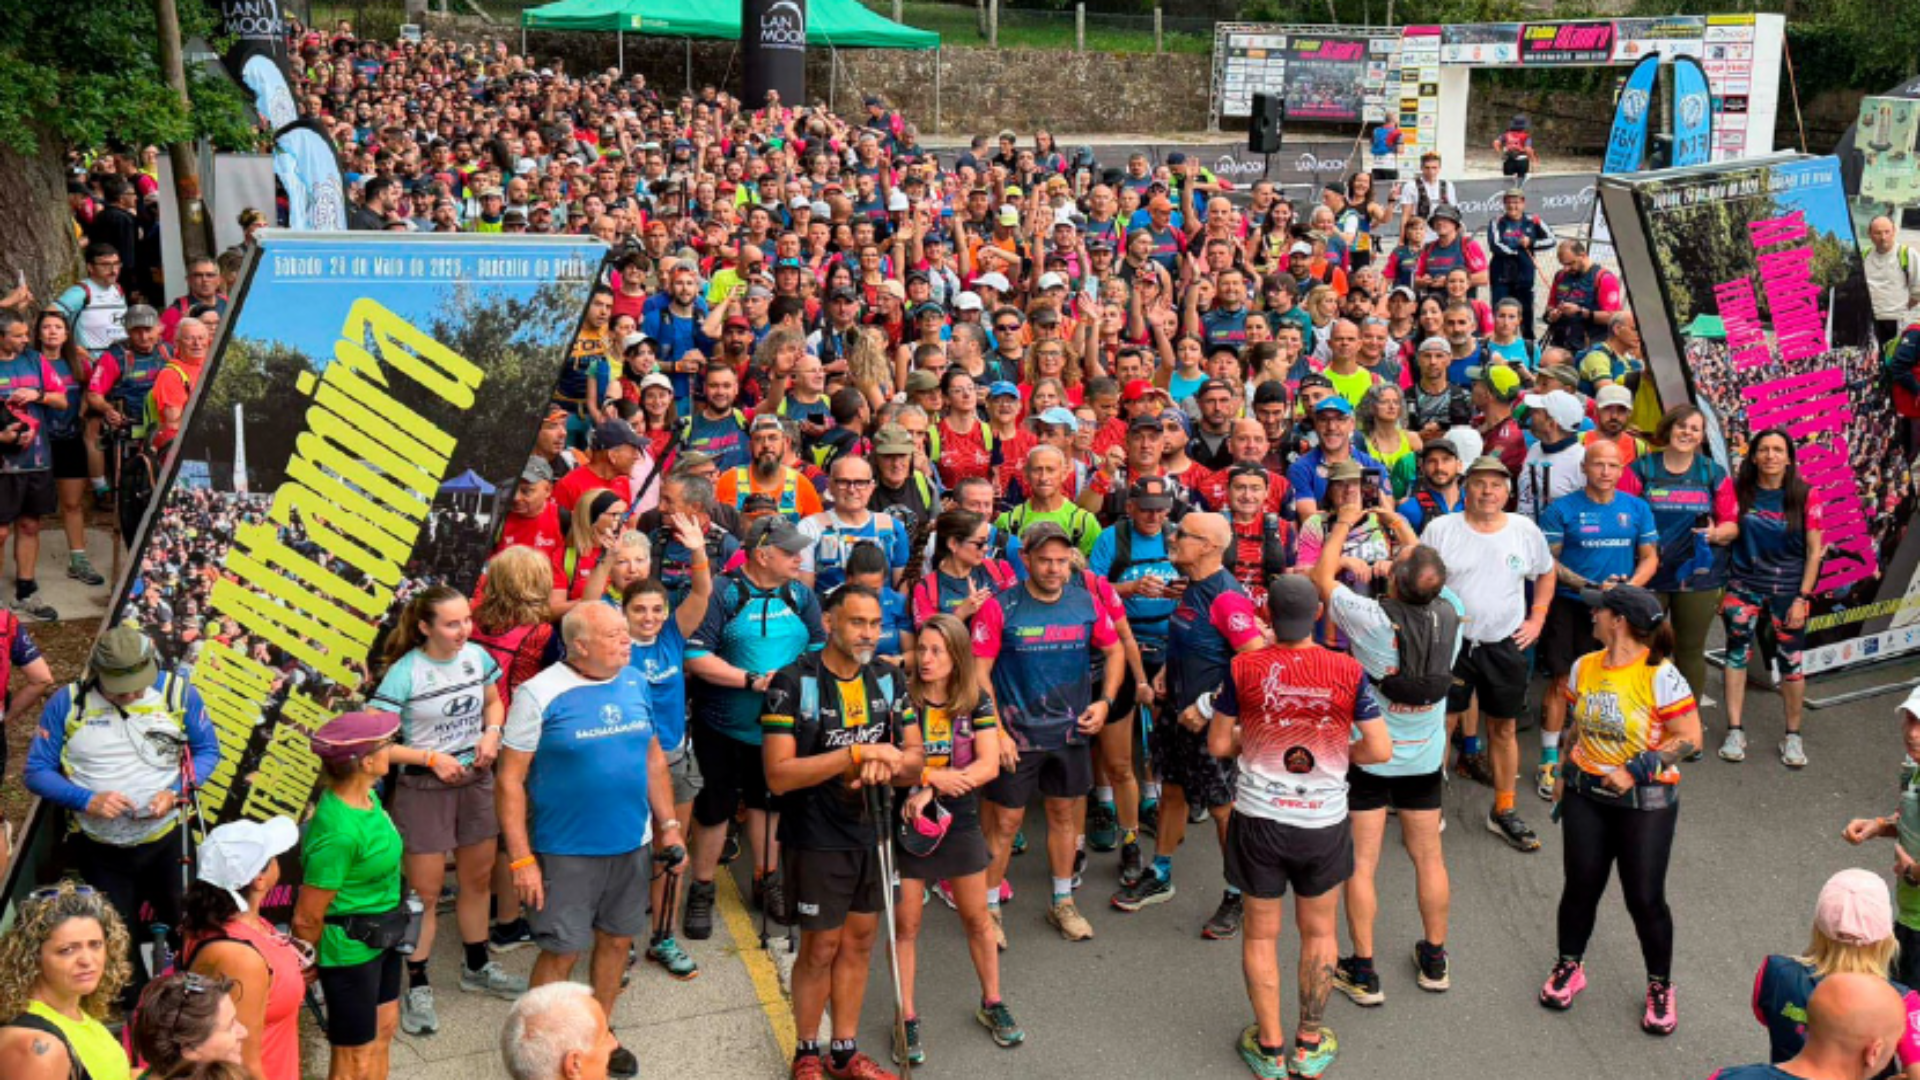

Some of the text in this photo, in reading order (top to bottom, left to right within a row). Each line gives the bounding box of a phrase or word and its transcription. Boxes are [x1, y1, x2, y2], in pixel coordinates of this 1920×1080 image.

[222, 1, 260, 18] LAN
[224, 17, 283, 34] MOON
[761, 15, 792, 29] LAN
[351, 256, 367, 276] de
[207, 297, 485, 690] Altamira
